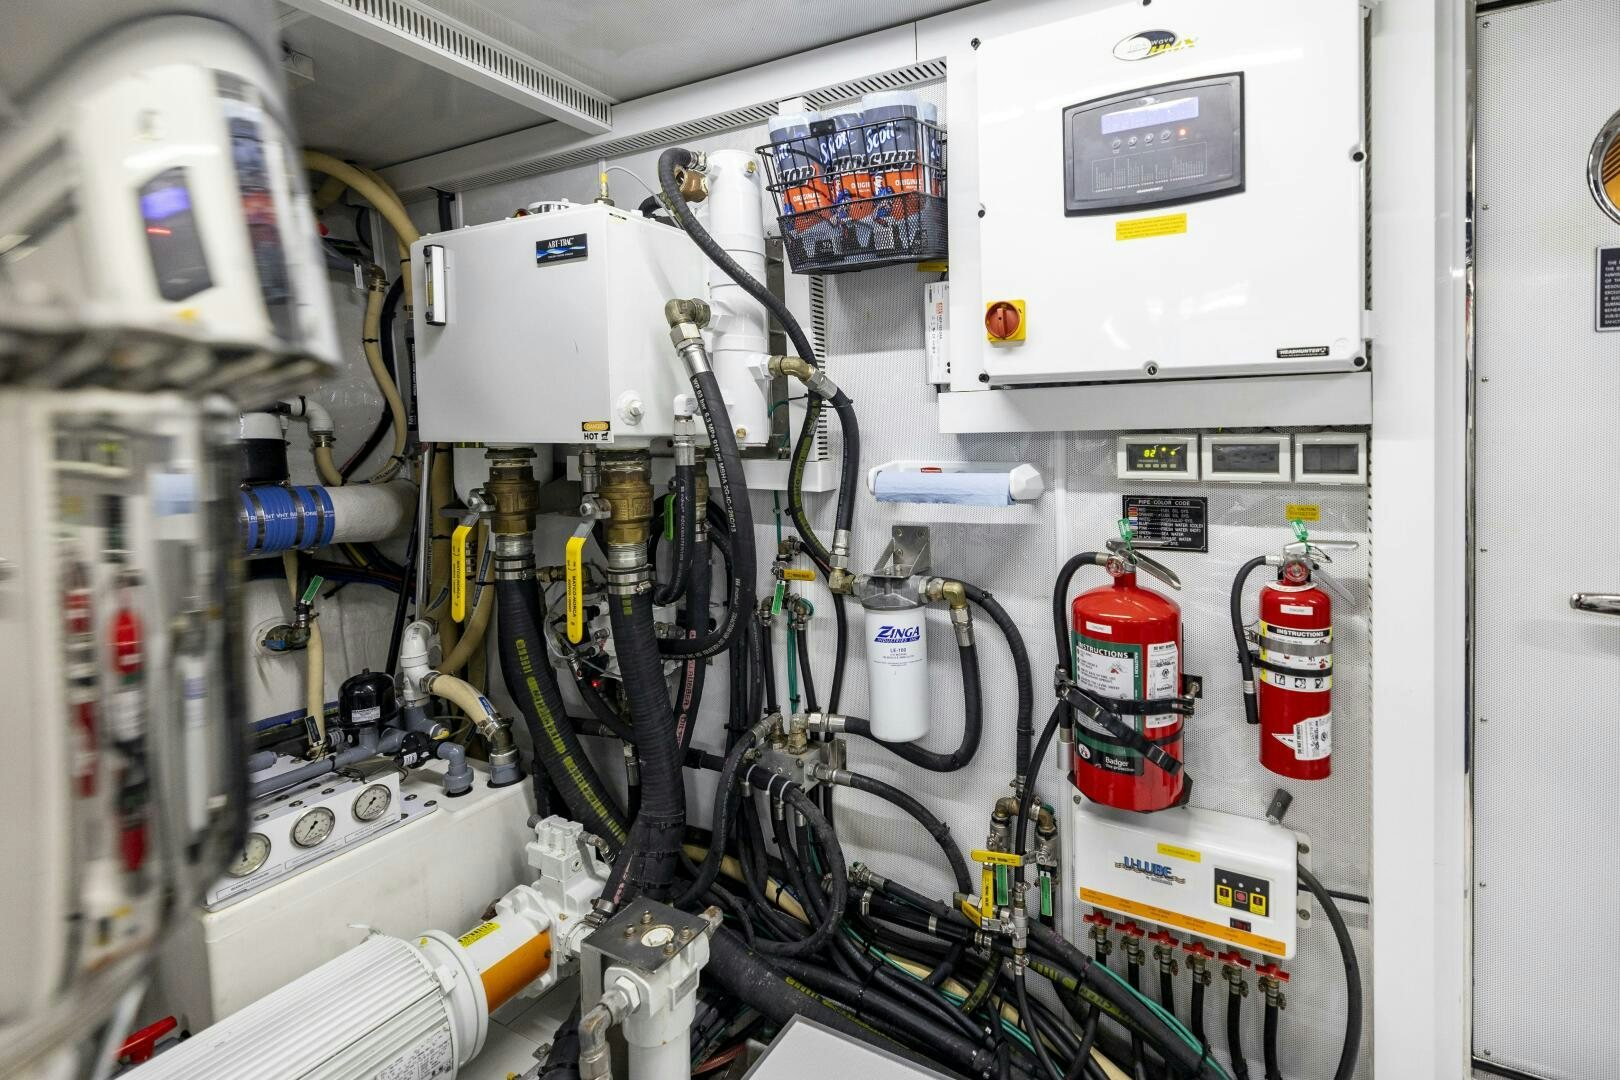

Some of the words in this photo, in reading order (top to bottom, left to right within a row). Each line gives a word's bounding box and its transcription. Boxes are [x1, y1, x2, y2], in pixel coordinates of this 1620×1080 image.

[1144, 449, 1156, 458] 82
[877, 625, 920, 638] ZINGA
[1277, 628, 1324, 637] INSTRUCTIONS
[1105, 756, 1129, 768] Badger
[1124, 856, 1172, 876] U-LUBE
